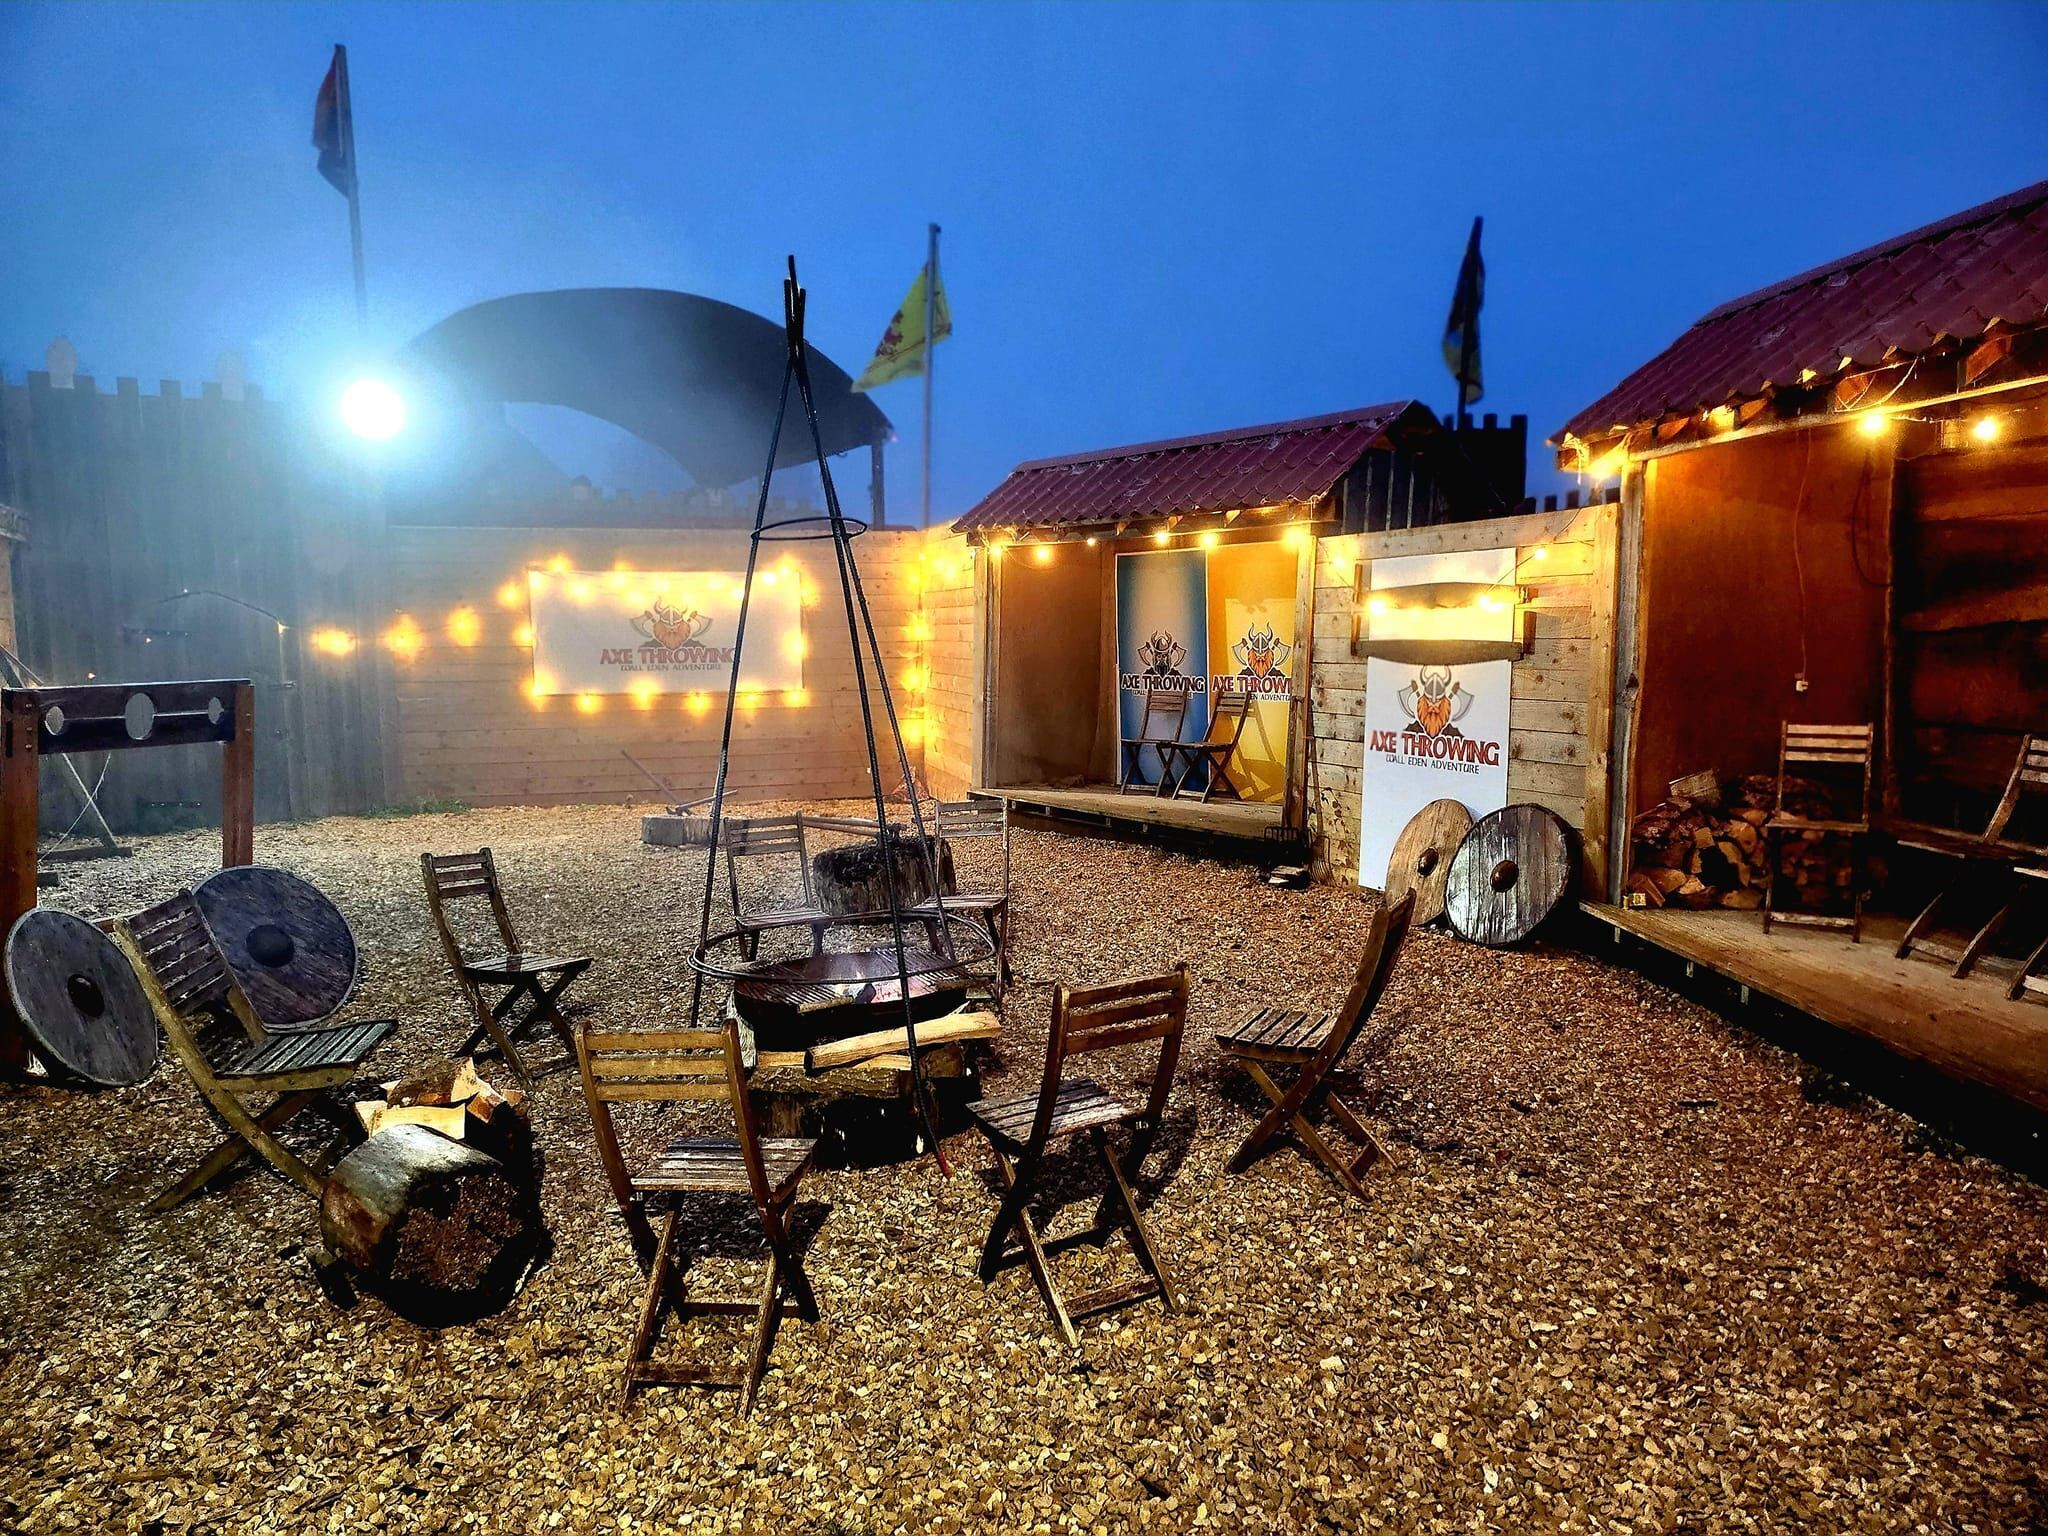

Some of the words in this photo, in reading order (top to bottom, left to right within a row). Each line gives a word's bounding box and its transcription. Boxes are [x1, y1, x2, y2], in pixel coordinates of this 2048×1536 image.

[600, 648, 633, 665] AXE
[1121, 675, 1140, 689] AXE
[1142, 675, 1205, 692] THROWING
[1212, 676, 1234, 691] AXE
[1237, 676, 1292, 693] THROWI
[1261, 693, 1291, 702] ADVENTU
[1370, 730, 1397, 753] AXE
[1401, 732, 1500, 766] THROWING
[1408, 756, 1428, 767] EDEN
[1430, 759, 1480, 774] ADVENTURE
